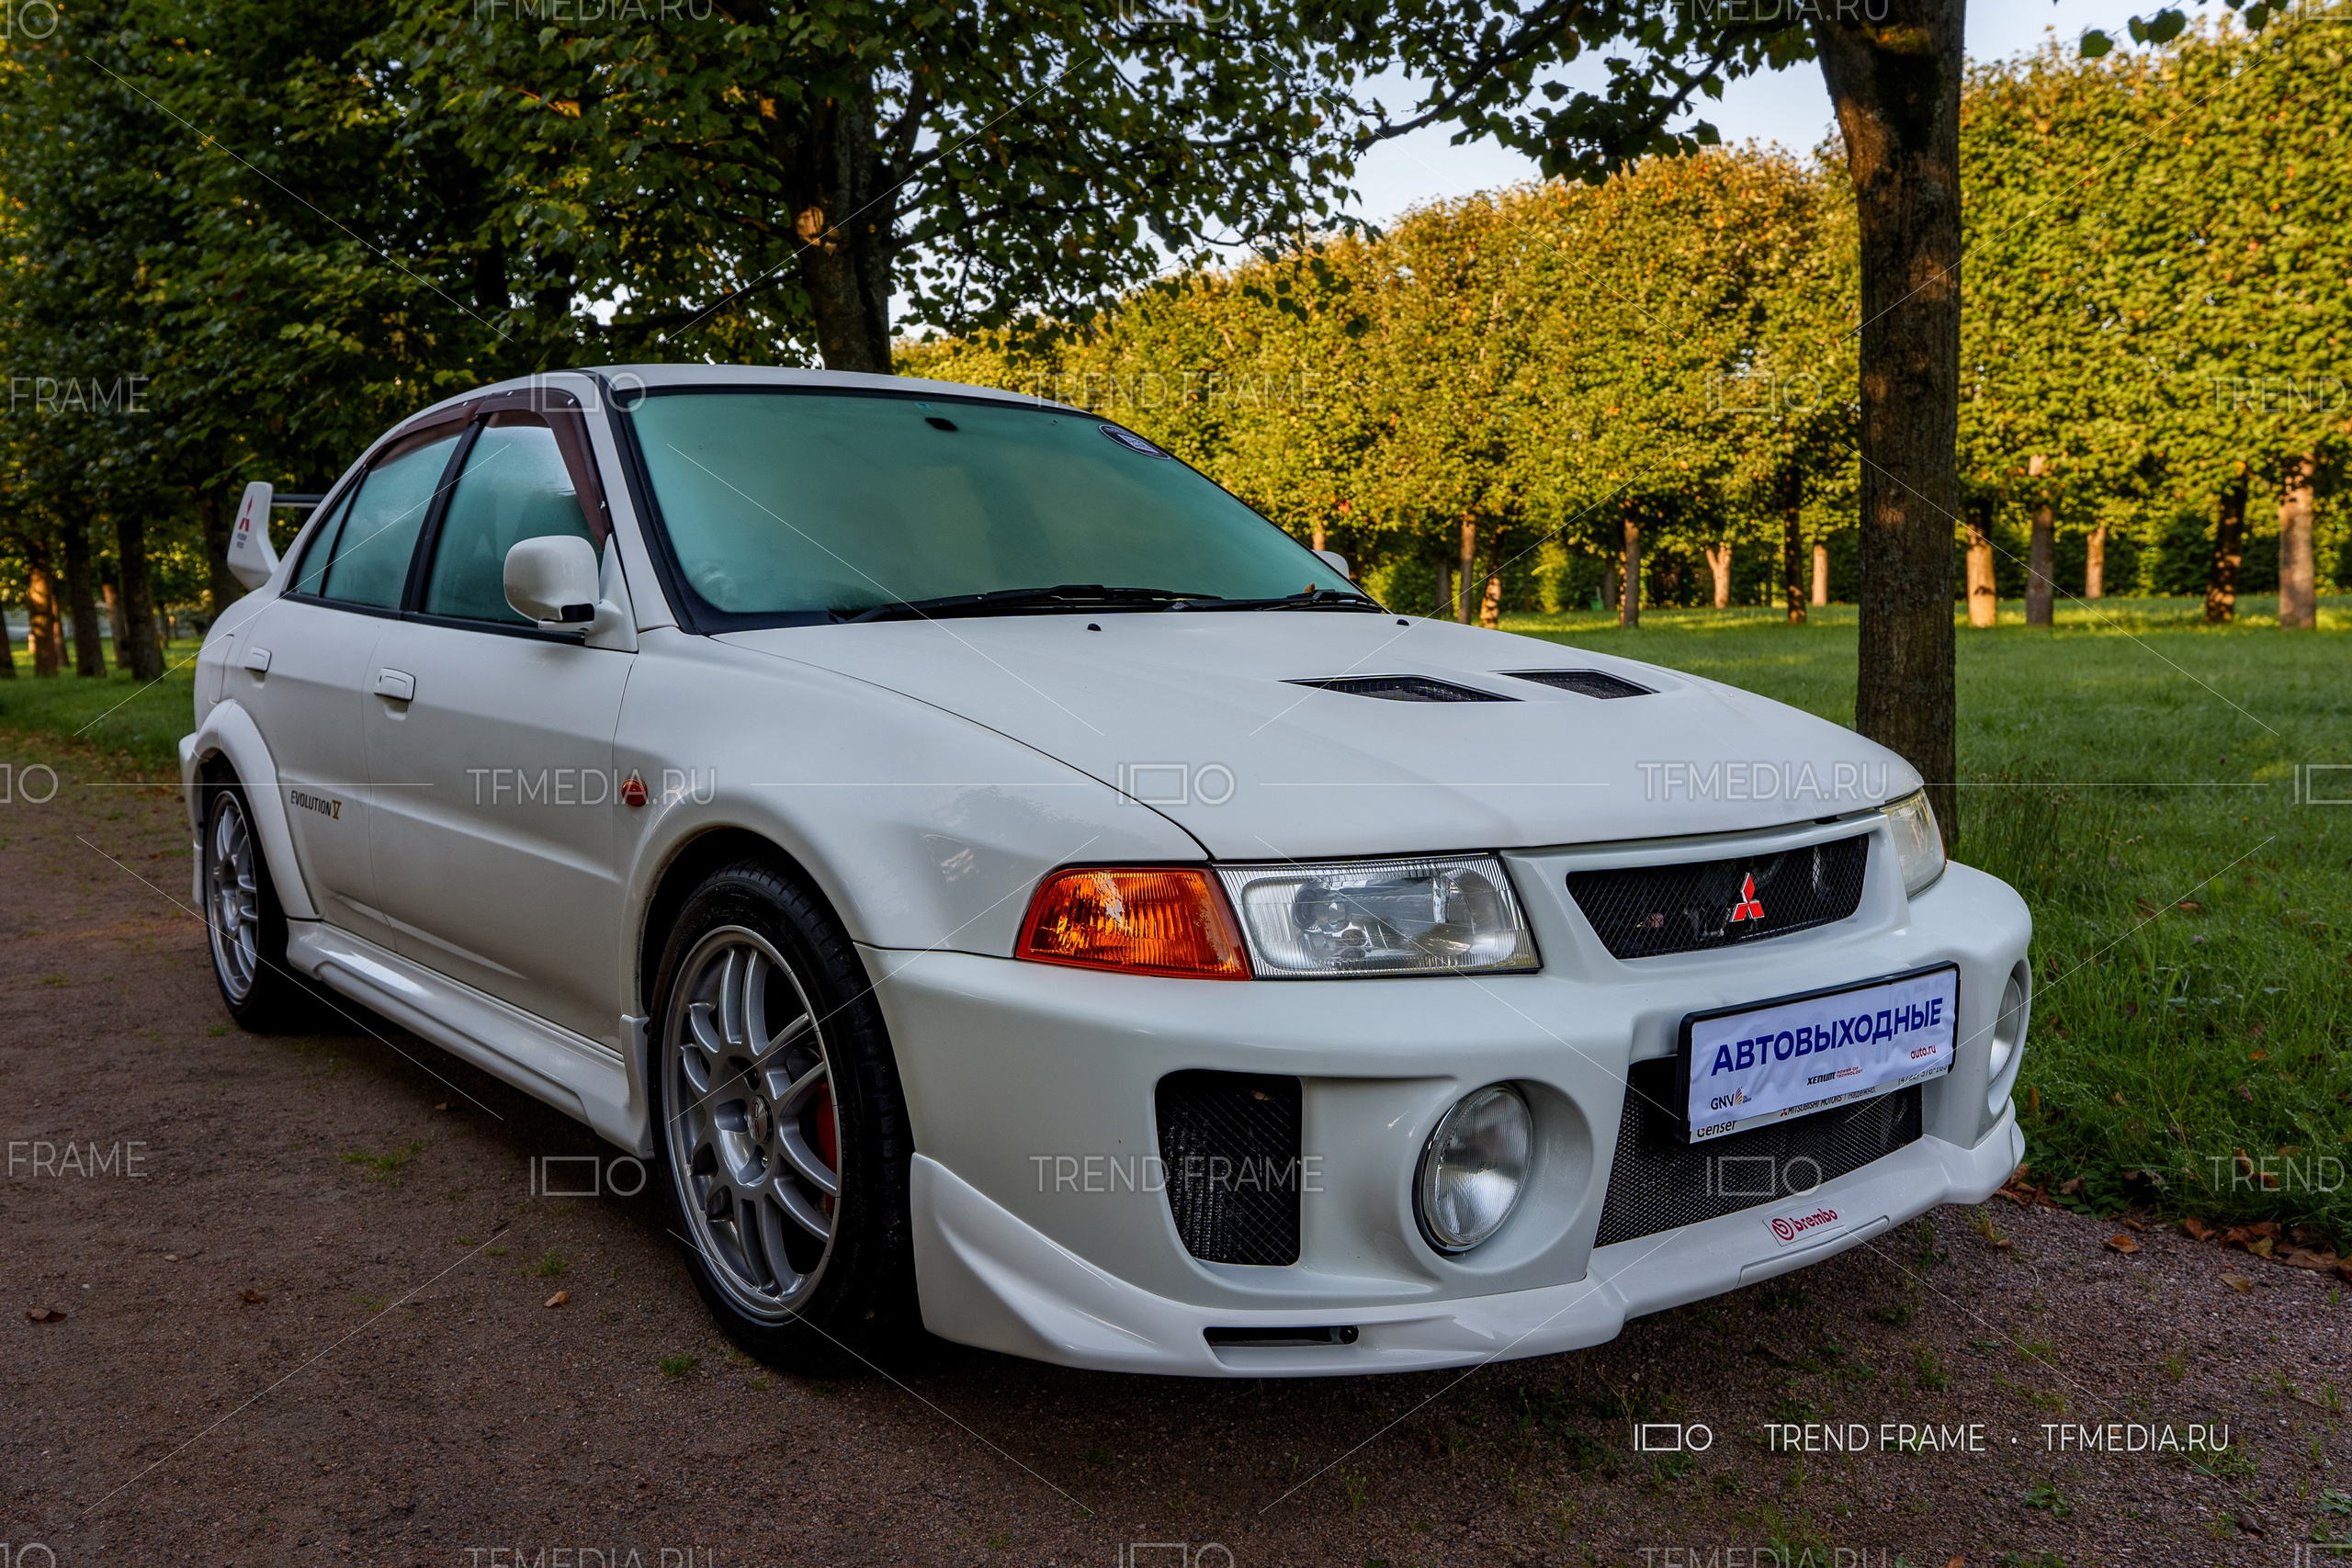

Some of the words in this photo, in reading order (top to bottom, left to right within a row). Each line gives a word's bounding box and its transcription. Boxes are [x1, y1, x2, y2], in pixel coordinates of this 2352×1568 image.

[290, 790, 332, 817] EVOLUTION
[332, 799, 342, 820] V
[1711, 997, 1943, 1077] АВТОВЫХОДНЫЕ
[1910, 1044, 1937, 1061] auto.ru
[1837, 1068, 1863, 1079] TECHNOLOGY
[1710, 1093, 1735, 1111] GNV
[1787, 1100, 1820, 1115] MITSUBISHI
[1789, 1208, 1838, 1233] brembo
